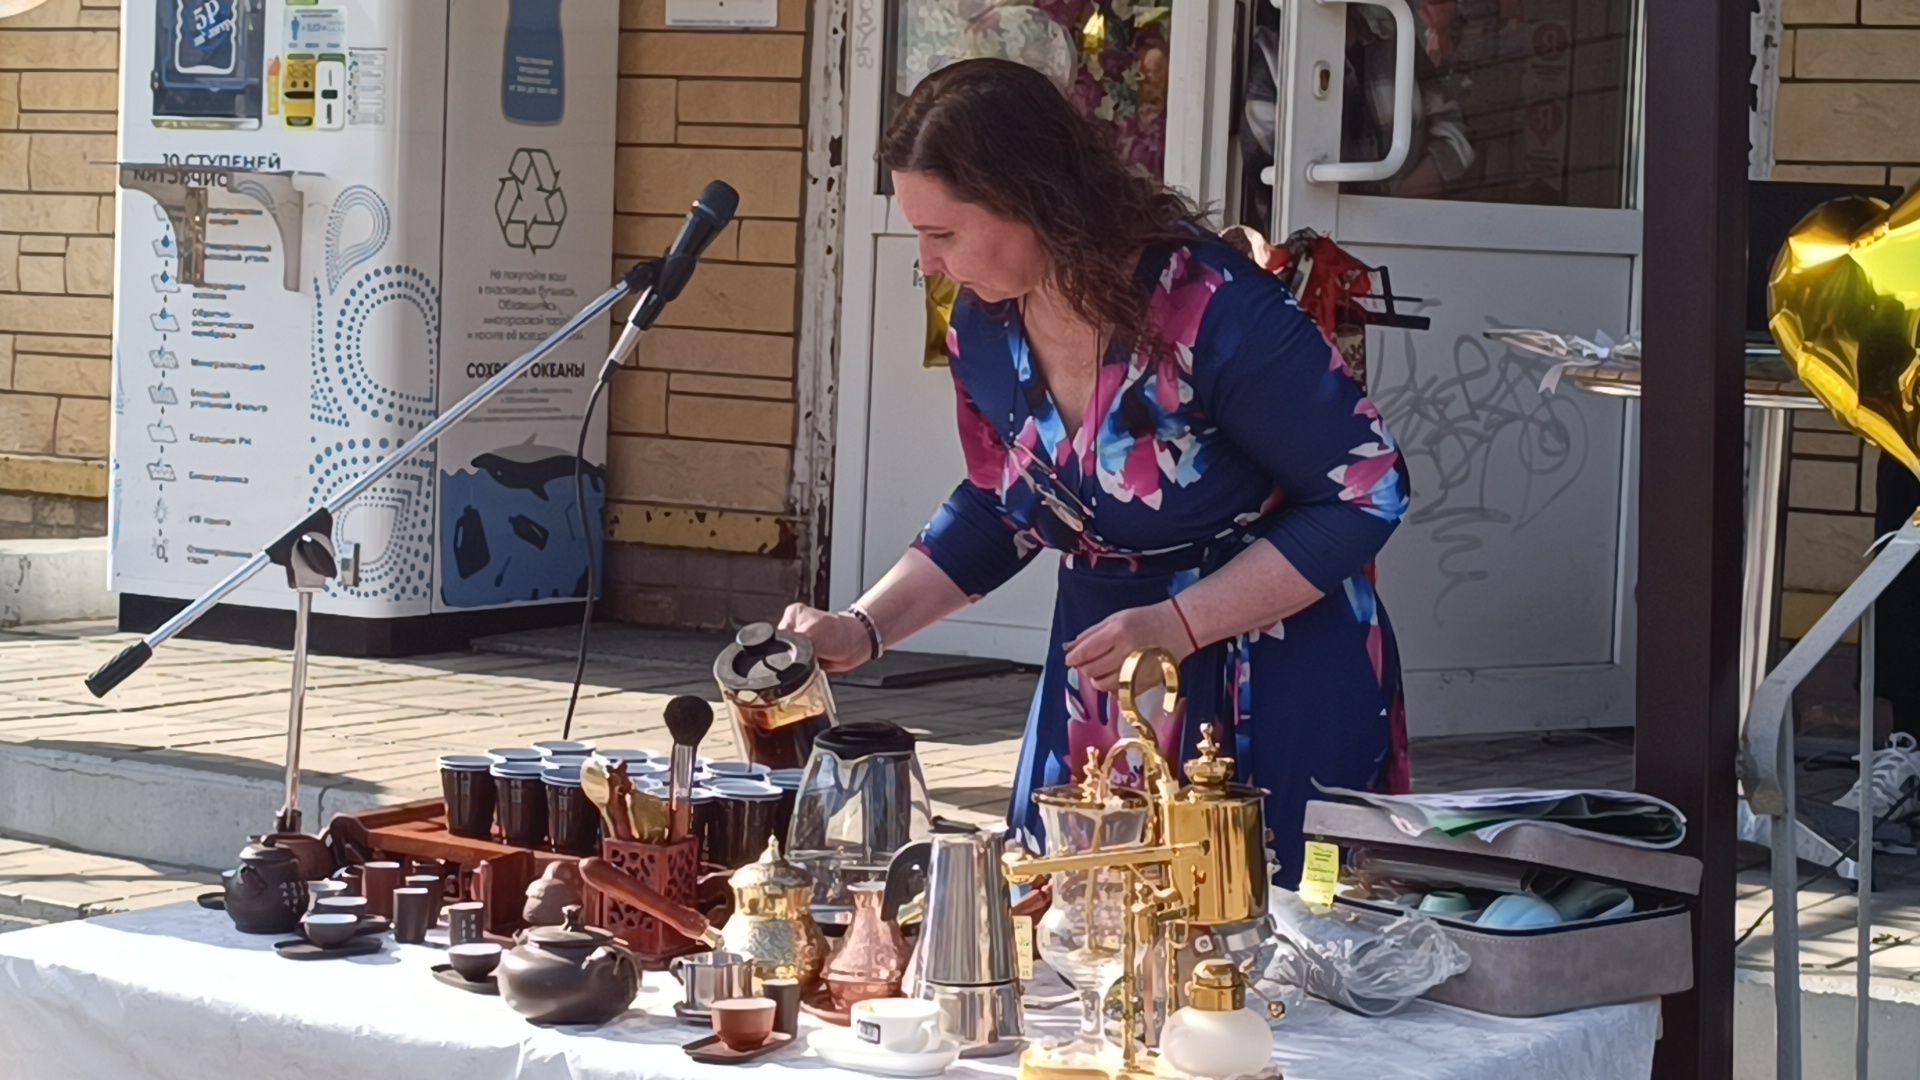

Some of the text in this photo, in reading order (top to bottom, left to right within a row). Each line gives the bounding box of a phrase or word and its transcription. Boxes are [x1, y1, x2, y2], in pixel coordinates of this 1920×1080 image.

[185, 153, 281, 170] СТУПЕНЕЙ
[466, 362, 585, 378] СОХР ОКЕАНЫ
